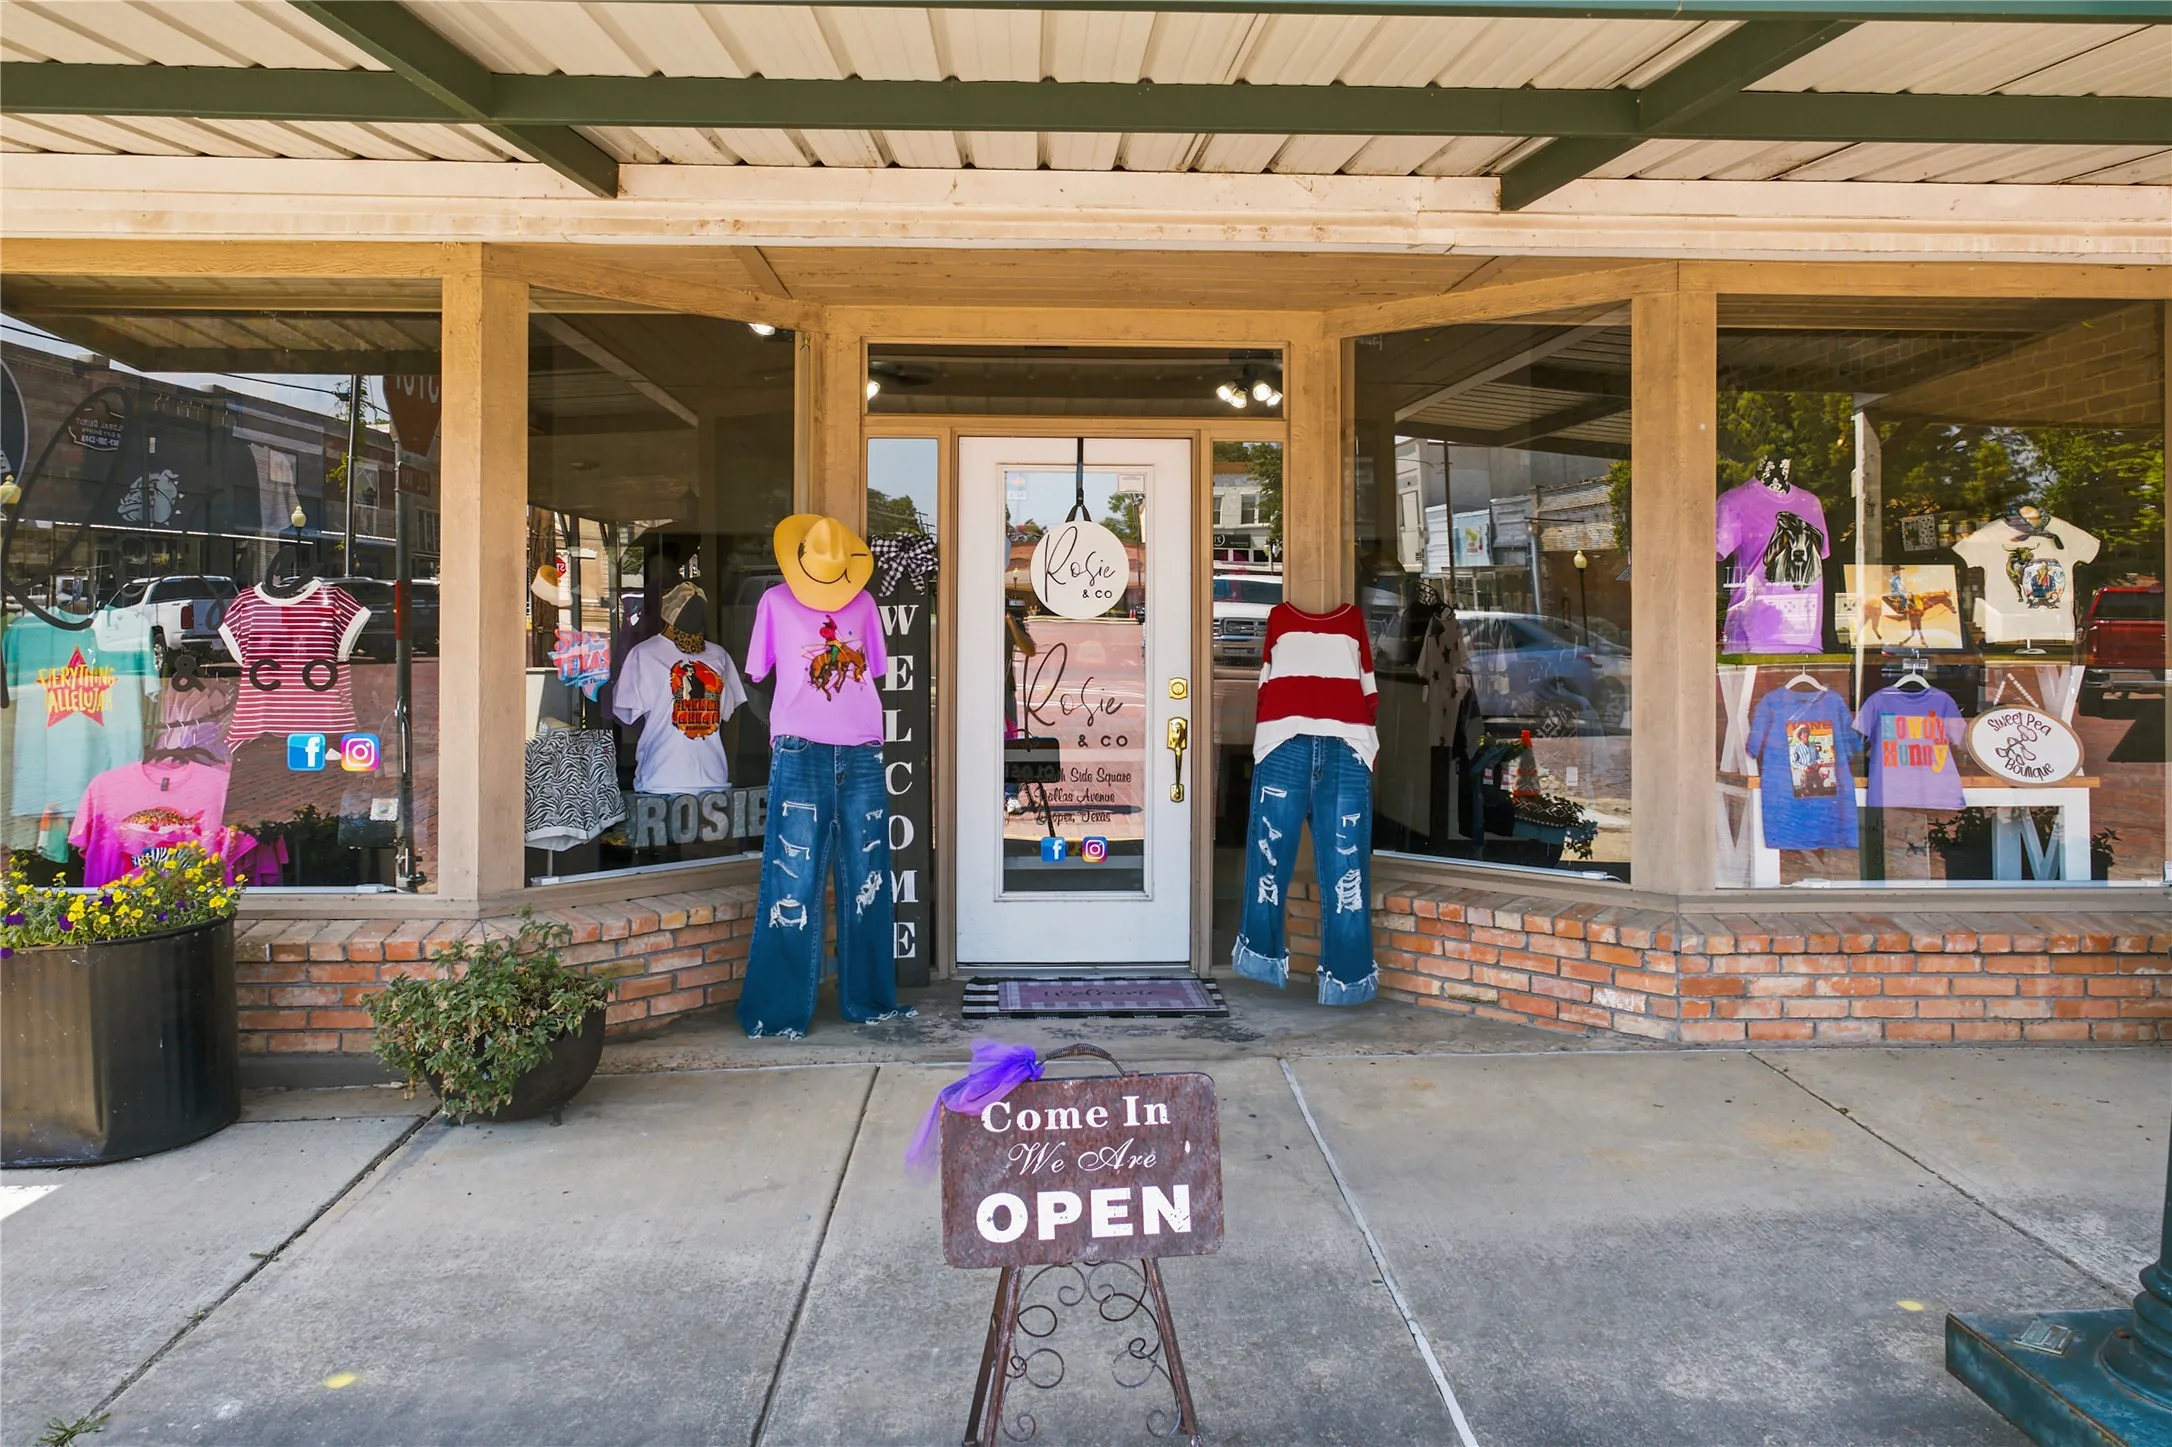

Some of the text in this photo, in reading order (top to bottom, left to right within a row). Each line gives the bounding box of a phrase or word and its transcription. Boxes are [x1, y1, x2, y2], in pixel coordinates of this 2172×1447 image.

[1044, 526, 1115, 602] Rosie
[1082, 589, 1112, 598] & CO
[37, 664, 117, 691] EVERYTHING
[171, 655, 206, 692] &
[1023, 643, 1123, 752] Rosie
[1078, 735, 1128, 747] & CO
[2026, 714, 2052, 736] Pea
[1883, 740, 1948, 773] Hunny
[878, 605, 919, 958] WELCOME
[1070, 767, 1093, 782] Side
[1097, 767, 1132, 786] Square
[1077, 788, 1115, 802] Avenue
[634, 790, 768, 847] ROSIE
[980, 1095, 1171, 1133] Come In
[1007, 1138, 1157, 1175] We Are
[976, 1184, 1192, 1244] OPEN
